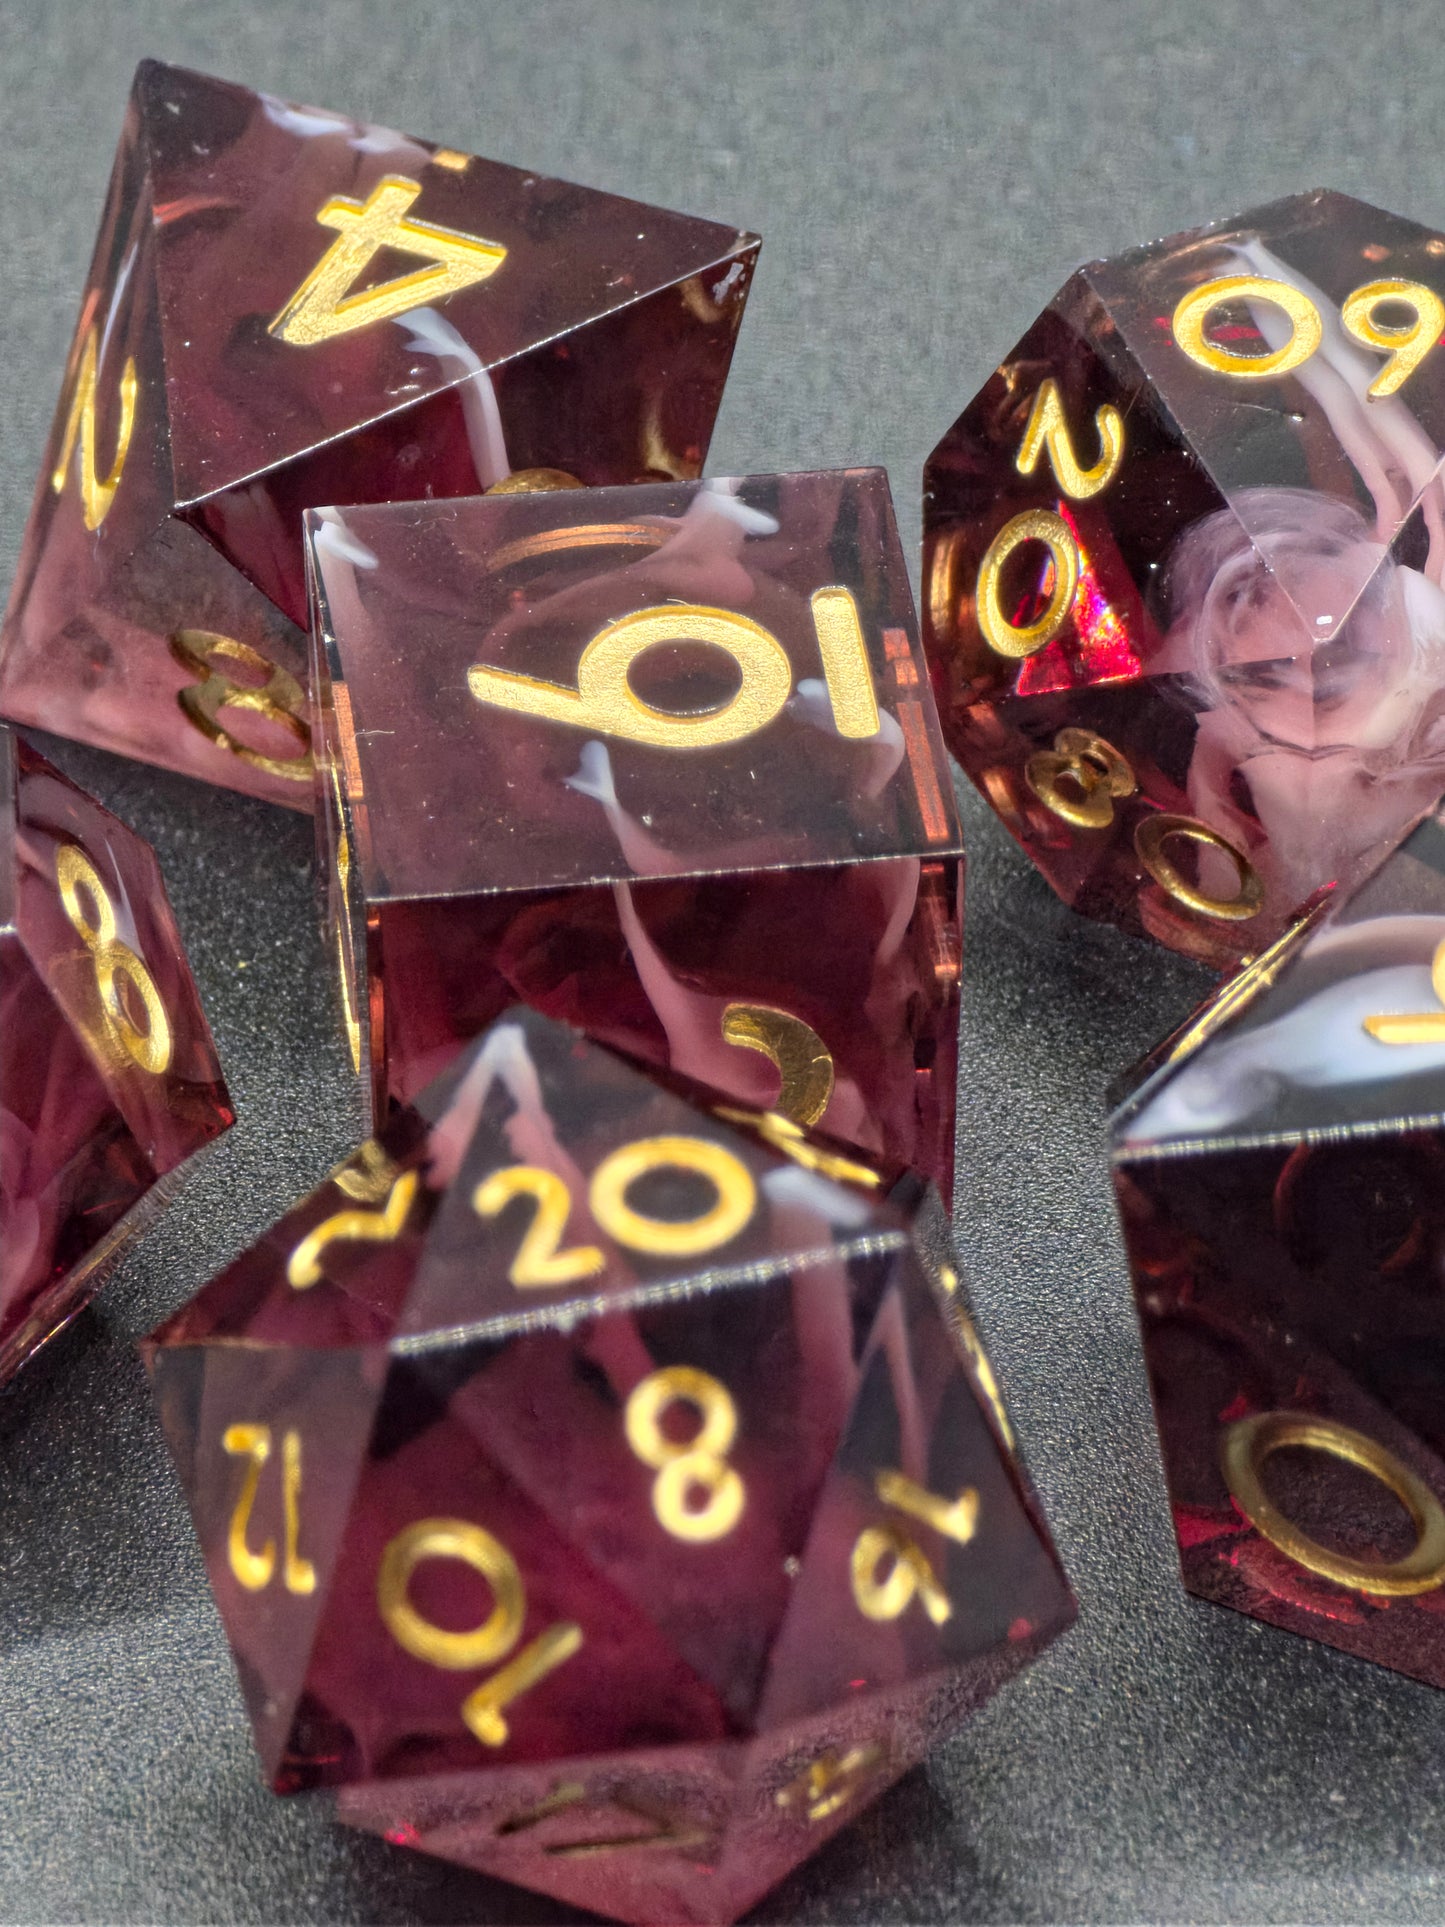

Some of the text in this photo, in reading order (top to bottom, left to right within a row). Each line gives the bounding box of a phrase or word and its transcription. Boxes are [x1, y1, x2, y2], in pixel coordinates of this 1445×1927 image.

[268, 174, 508, 346] 4
[473, 1136, 757, 1289] 20
[625, 1365, 746, 1543] 8
